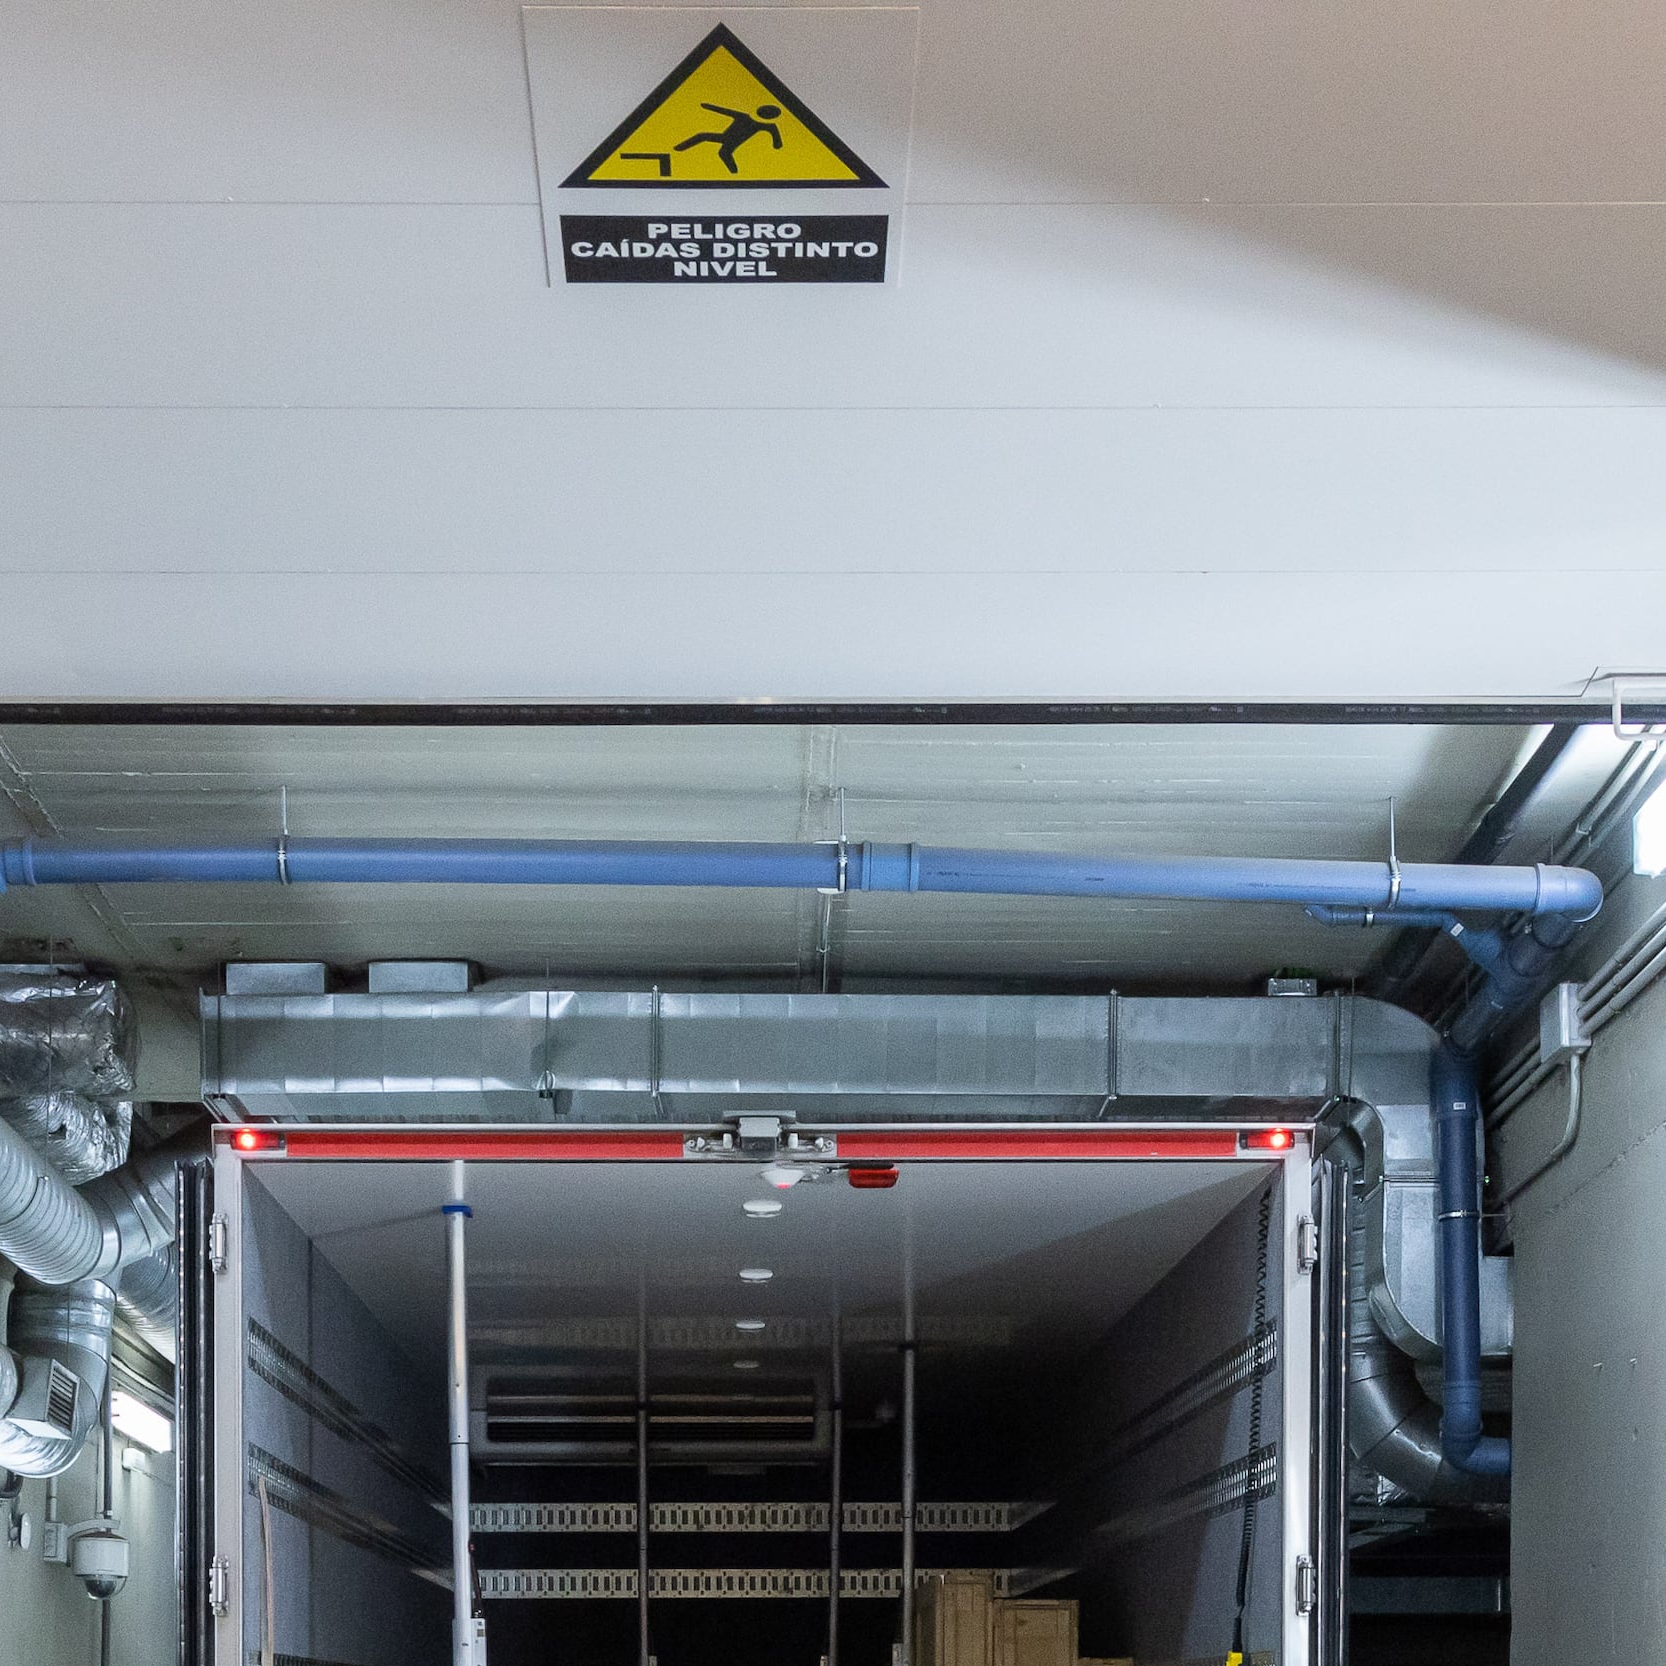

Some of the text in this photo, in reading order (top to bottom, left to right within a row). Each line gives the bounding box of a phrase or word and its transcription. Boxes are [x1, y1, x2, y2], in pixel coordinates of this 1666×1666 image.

[647, 223, 802, 239] PELIGRO
[571, 239, 879, 258] CAÍDAS DISTINTO
[674, 261, 777, 277] NIVEL
